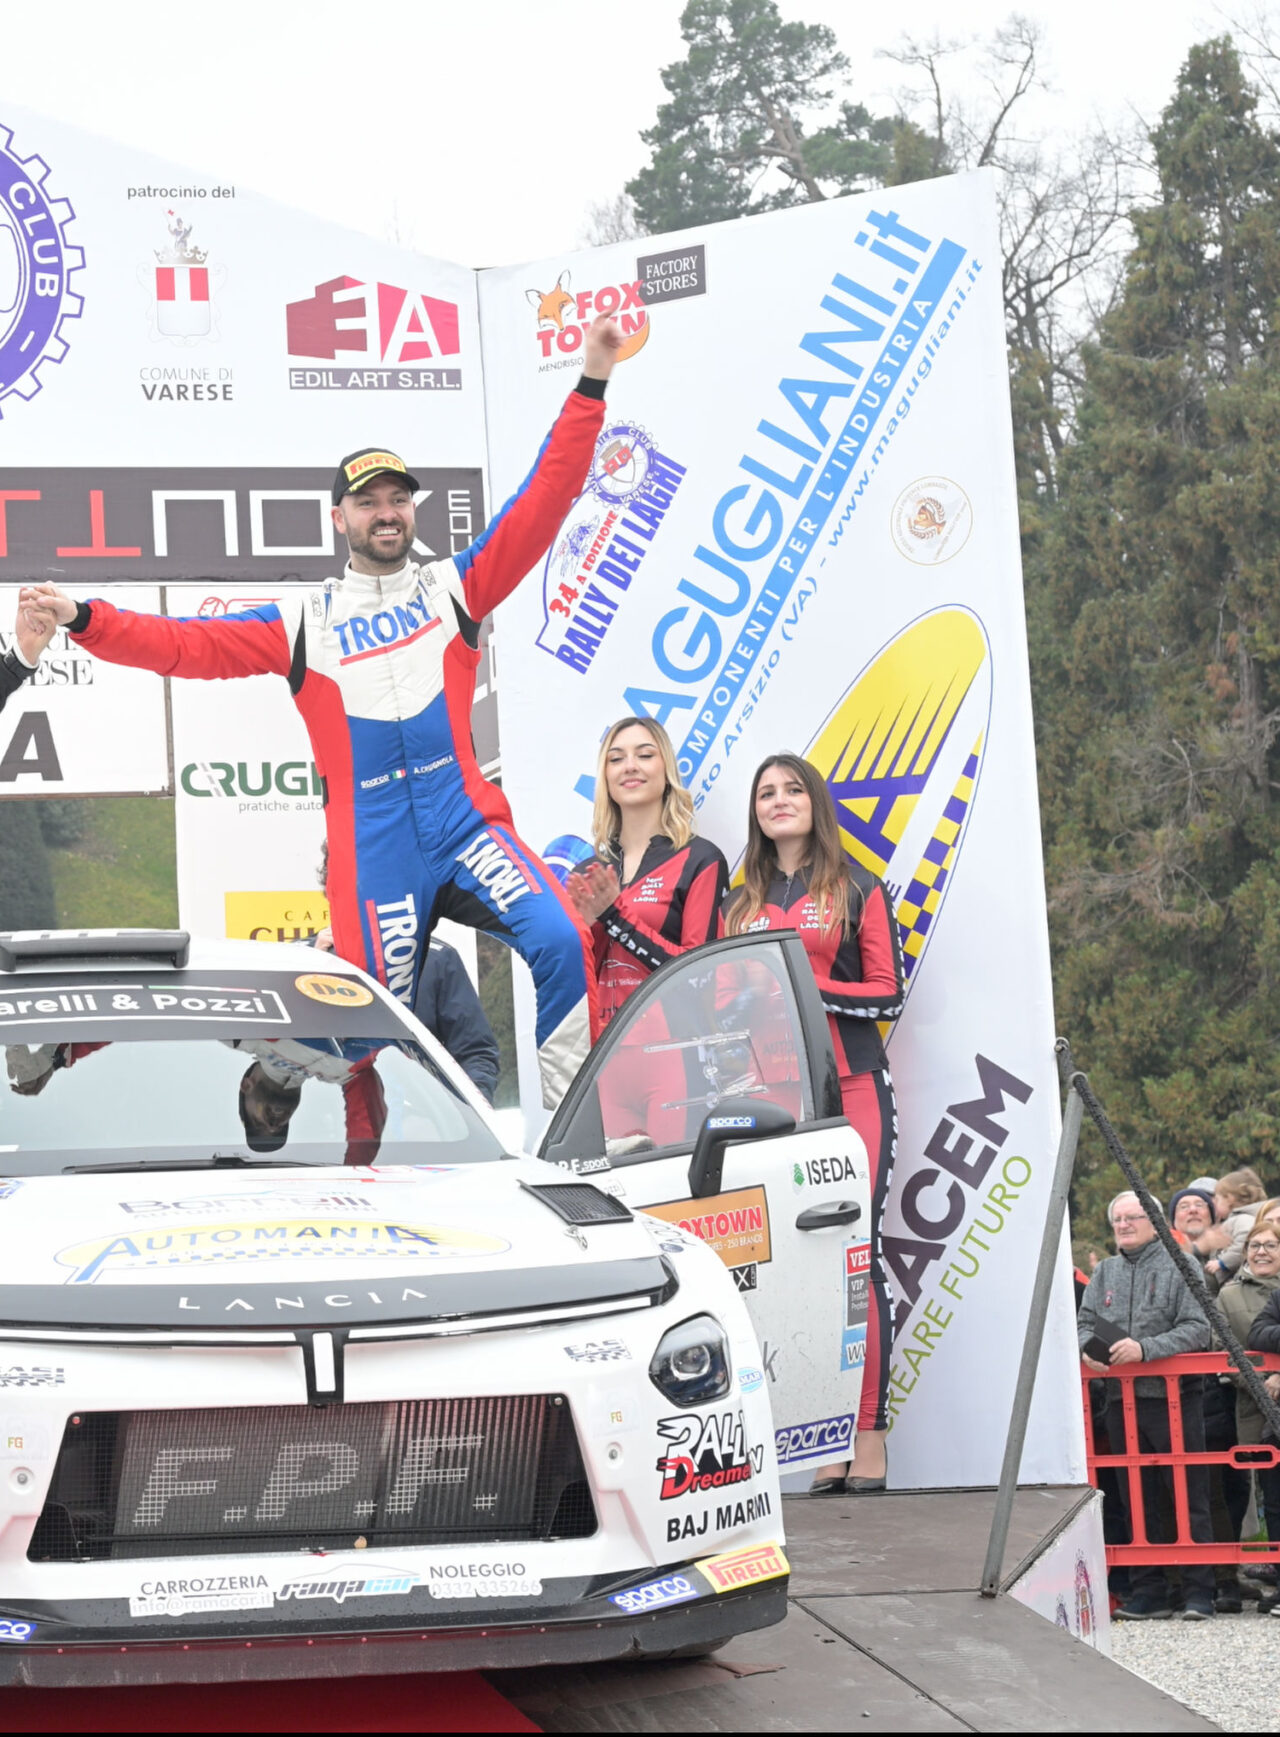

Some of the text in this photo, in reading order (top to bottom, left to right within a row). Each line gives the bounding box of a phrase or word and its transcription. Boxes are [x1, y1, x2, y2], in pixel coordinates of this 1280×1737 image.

[126, 185, 236, 201] patrocinio del
[8, 181, 60, 298] CLUB
[646, 256, 698, 280] FACTORY
[646, 272, 698, 296] STORES
[576, 280, 646, 320] FOX
[537, 310, 646, 358] TON
[139, 367, 234, 382] COMUNE DI
[290, 371, 462, 389] EDIL ART S.R.L.
[538, 357, 585, 374] MENDRISIO
[141, 383, 234, 402] VARESE
[573, 209, 933, 806] AGUGLIANI.it
[723, 650, 781, 758] Arsizio
[780, 576, 819, 642] (VA)
[829, 257, 984, 547] www.magugliani.it
[677, 588, 781, 782] OMPONENTI
[780, 514, 820, 574] PER
[815, 298, 933, 503] L'INDUSTRIA
[549, 583, 580, 618] 34
[582, 510, 619, 572] EDIZIONE
[556, 450, 688, 676] RALLY DEI LAGHI
[332, 594, 433, 657] TRONY
[238, 799, 291, 814] pratiche
[453, 829, 532, 914] TRONY
[376, 893, 420, 1005] TRONY
[112, 995, 141, 1012] &
[156, 993, 268, 1016] Pozzi
[708, 1116, 752, 1129] sparco
[805, 1156, 857, 1187] ISEDA
[739, 1233, 764, 1248] BRANDS
[939, 1154, 1033, 1301] FUTURO
[74, 1224, 440, 1283] AUTOMANIA
[179, 1288, 428, 1311] LANCIA
[851, 1279, 865, 1292] VIP
[775, 1418, 853, 1460] sparco
[131, 1434, 499, 1528] F.P.F.
[667, 1491, 771, 1543] BAJ MARMI
[141, 1574, 269, 1596] CARROZZERIA
[430, 1562, 527, 1579] NOLEGGIO
[706, 1545, 783, 1586] PIRELLI
[613, 1576, 692, 1612] sparco
